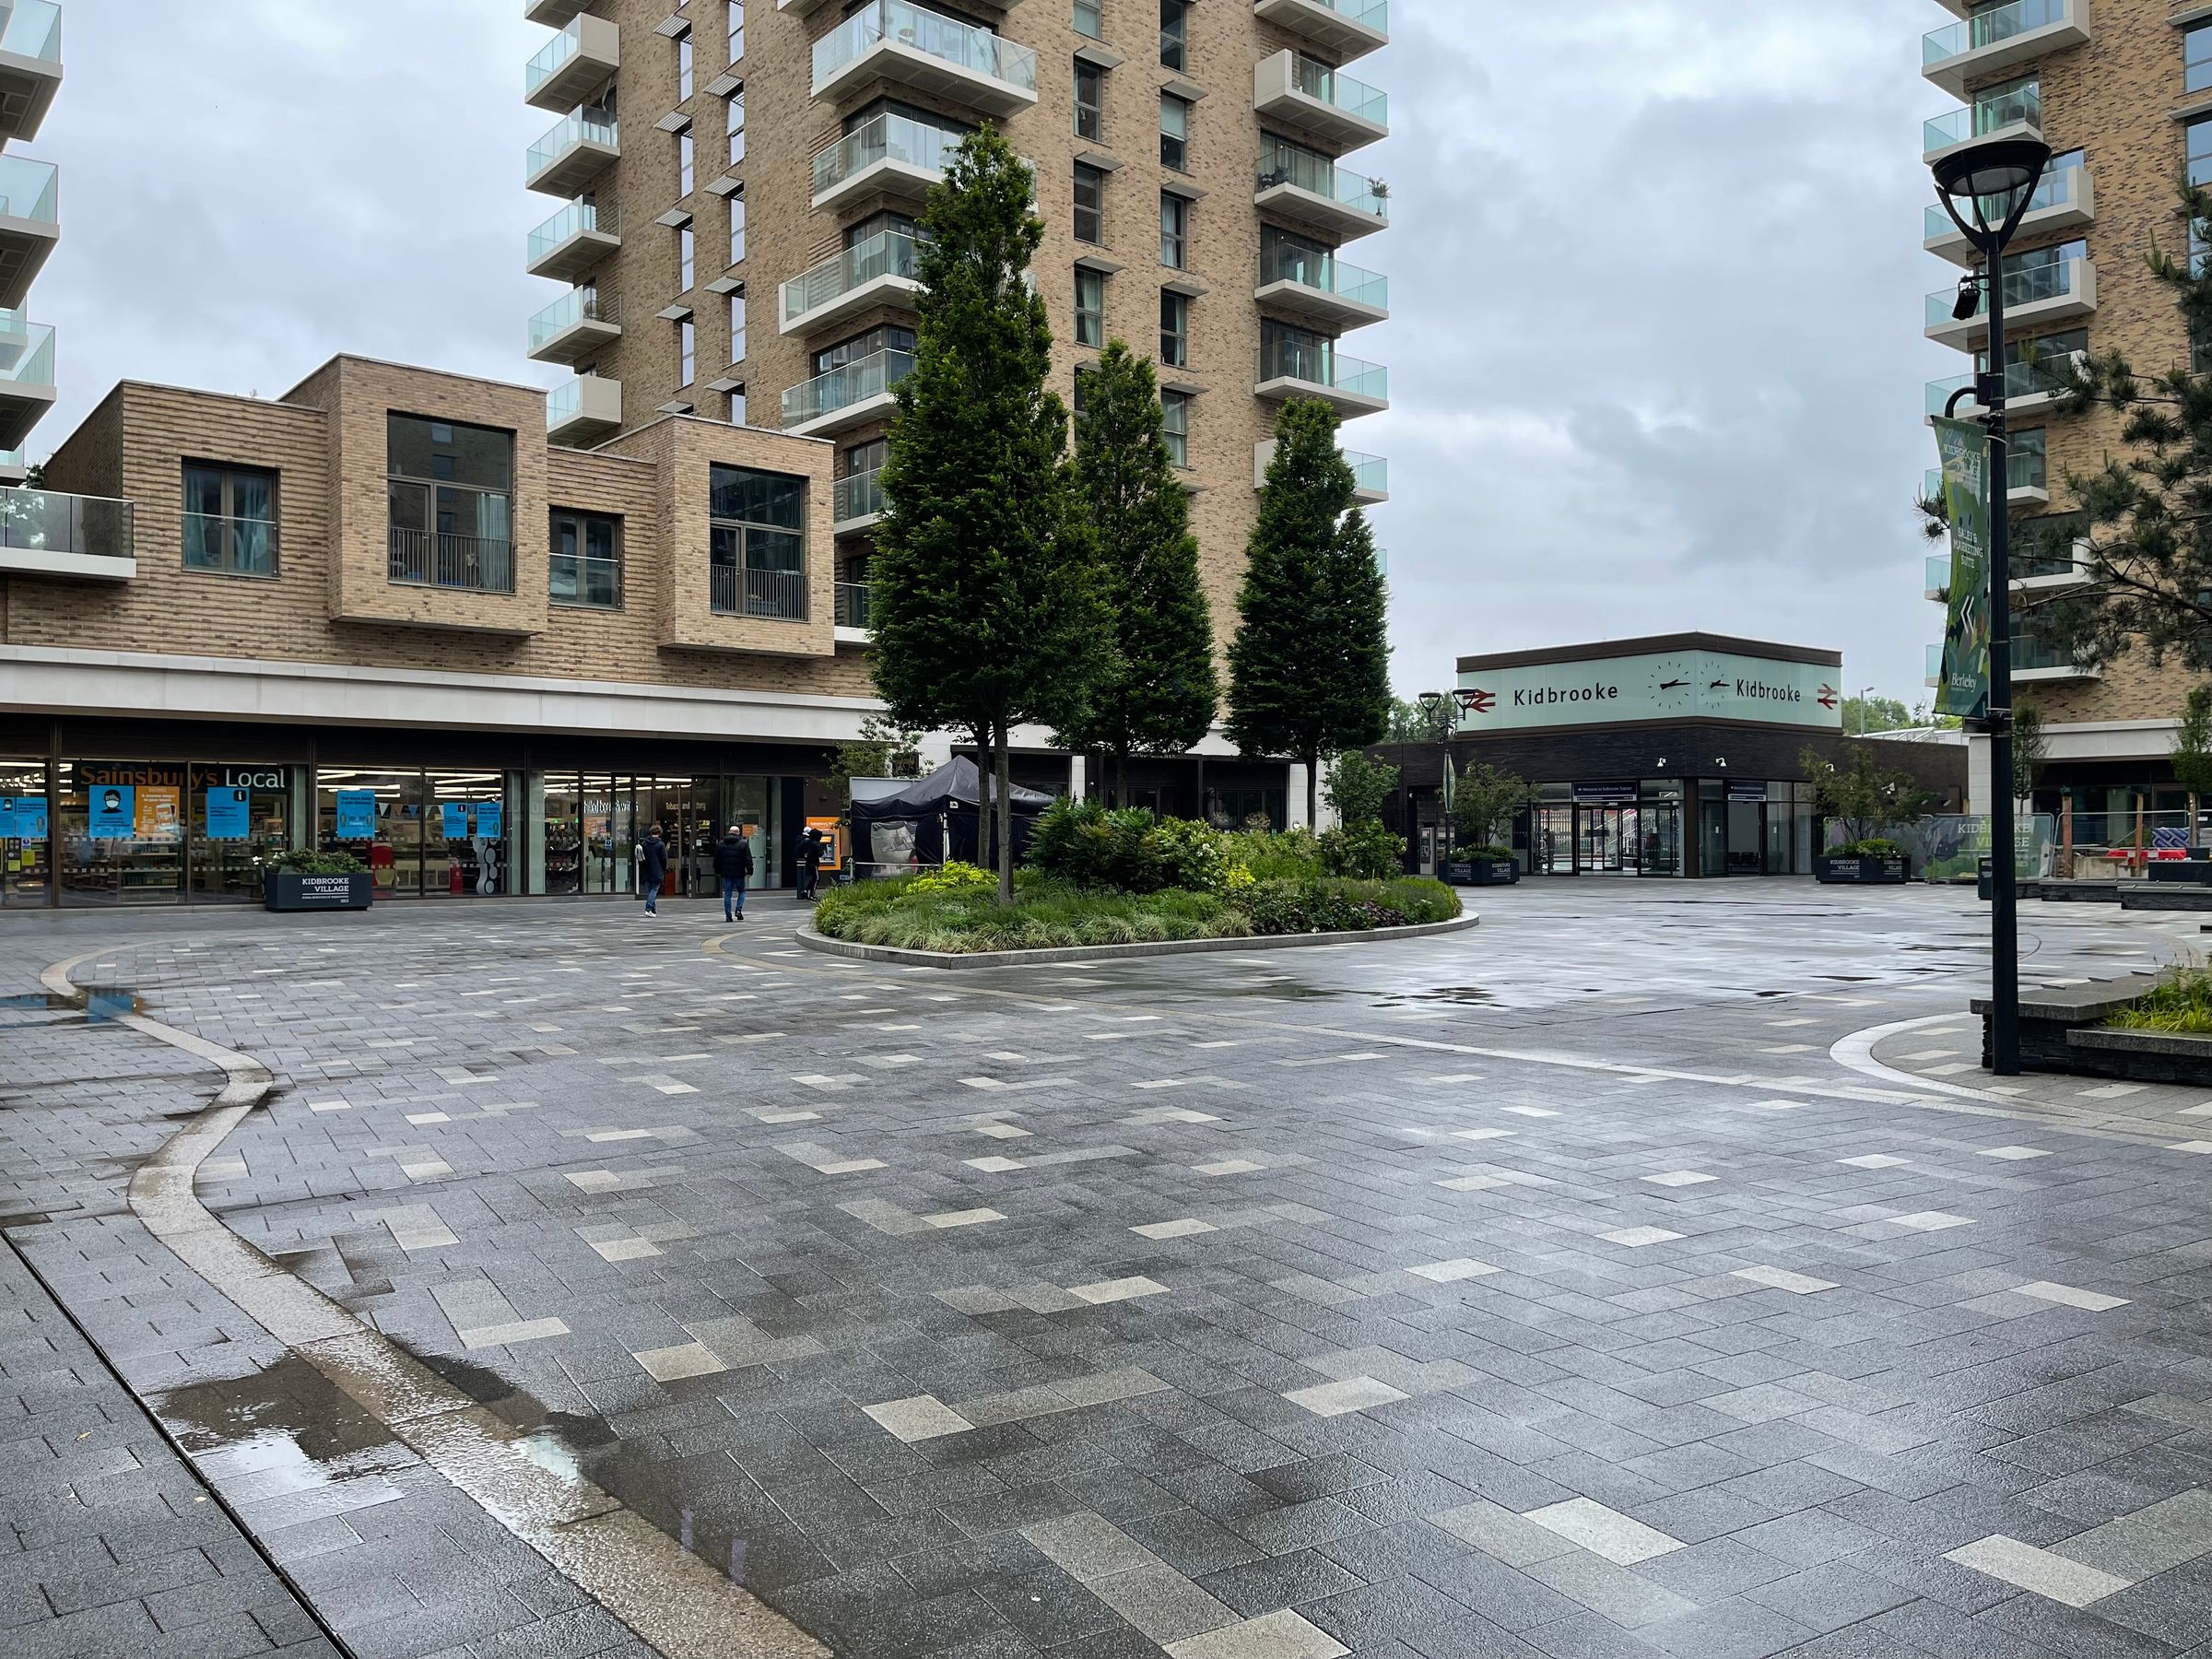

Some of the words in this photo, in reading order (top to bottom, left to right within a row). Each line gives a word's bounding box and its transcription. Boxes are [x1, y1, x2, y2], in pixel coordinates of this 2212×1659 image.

[1513, 682, 1618, 706] Kidbrooke
[1735, 678, 1801, 702] Kidbrooke
[1951, 672, 1977, 693] Berkeley
[80, 765, 218, 791] Sainsbury's
[225, 768, 286, 788] Local
[1958, 823, 2030, 834] KIDBKE
